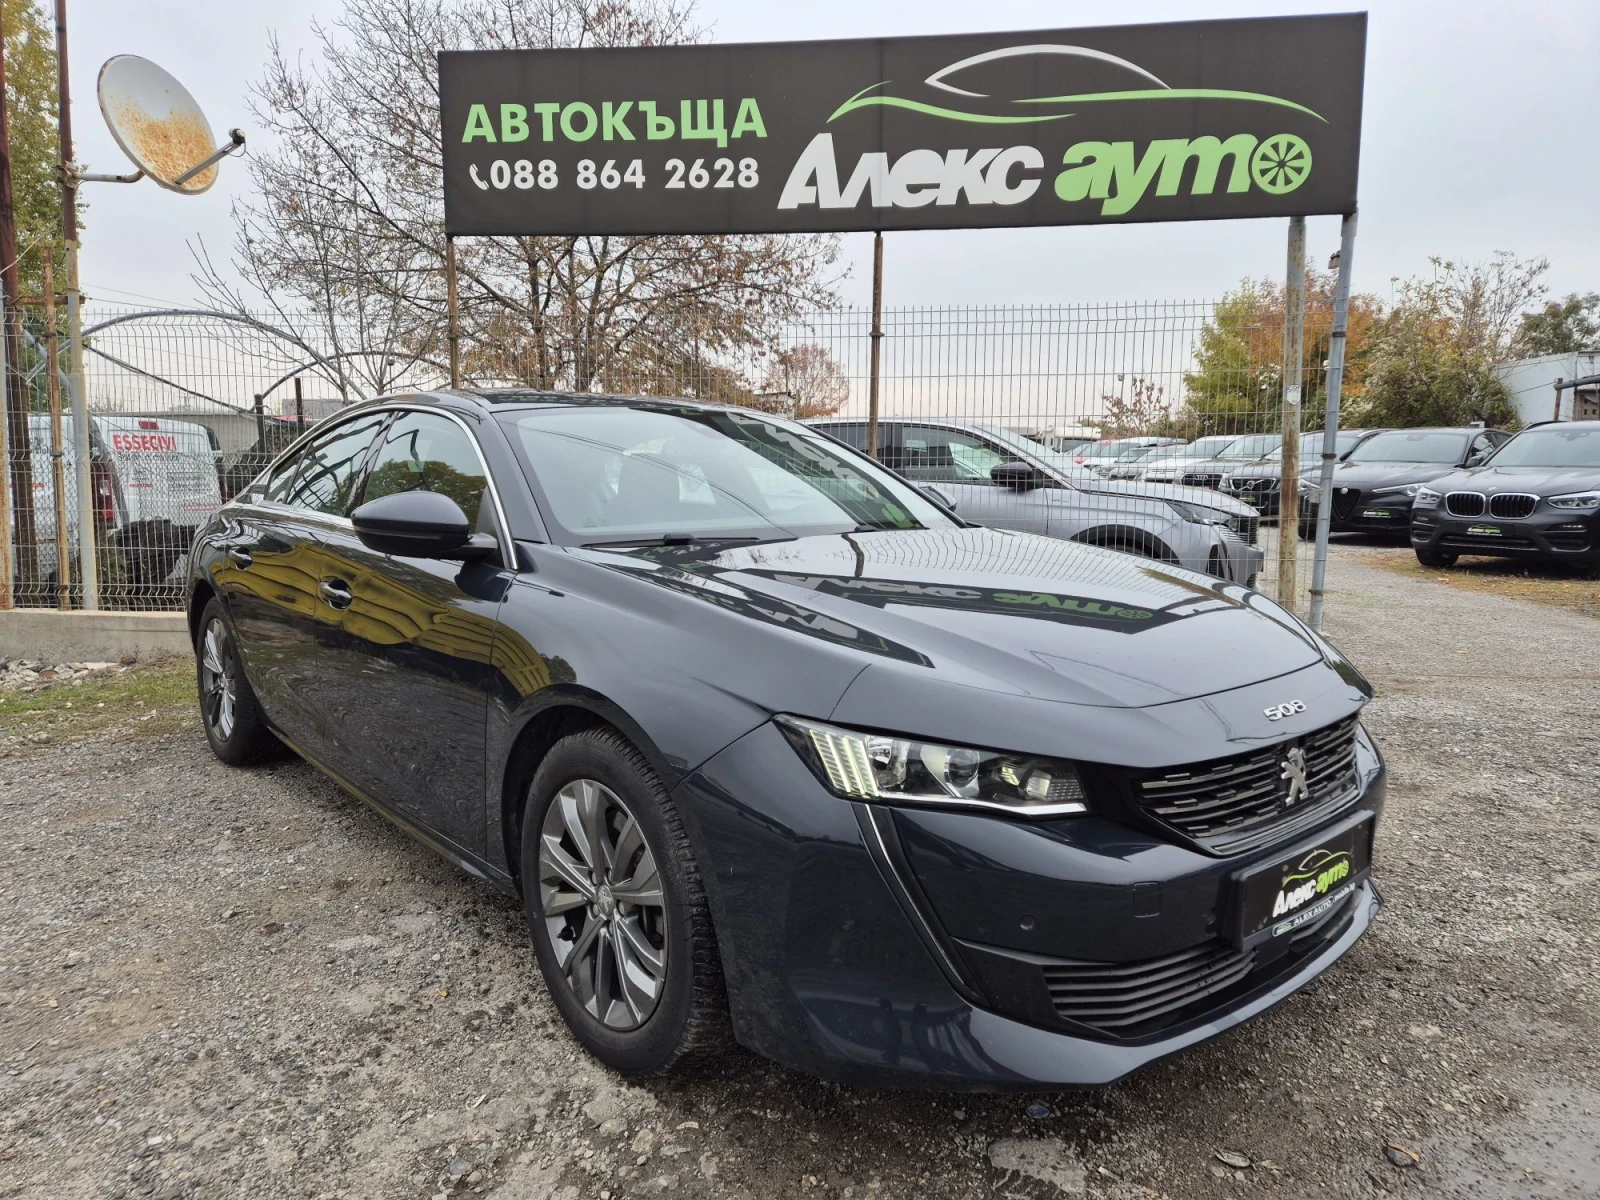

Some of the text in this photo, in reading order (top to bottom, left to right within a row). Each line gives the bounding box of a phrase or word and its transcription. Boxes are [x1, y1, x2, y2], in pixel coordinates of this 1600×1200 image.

[461, 97, 768, 148] АВТОКЪЩА
[490, 157, 760, 190] 088 864 2628
[776, 132, 1045, 210] Алекс
[112, 433, 177, 452] ESSECIVI
[1262, 699, 1307, 721] 508
[1272, 878, 1317, 918] Алекс
